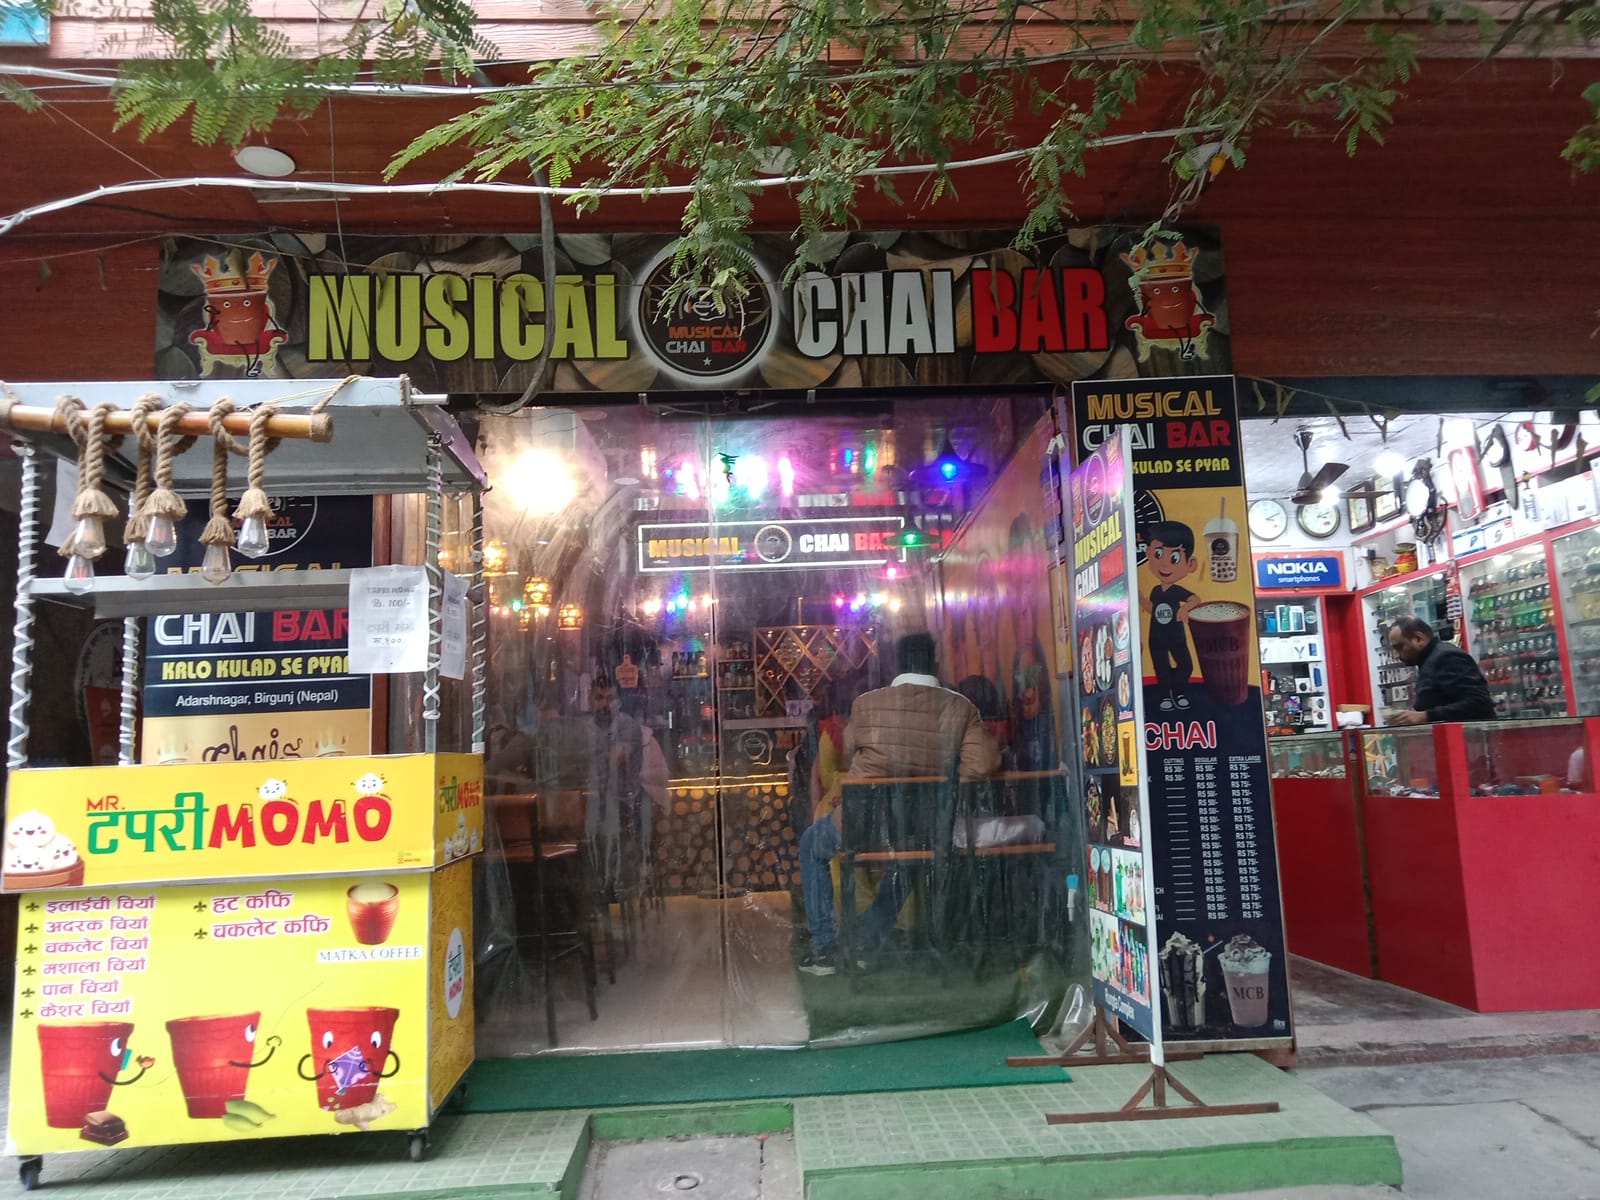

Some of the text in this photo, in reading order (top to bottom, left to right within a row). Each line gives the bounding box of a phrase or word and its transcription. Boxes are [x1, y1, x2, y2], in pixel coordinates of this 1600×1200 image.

[308, 268, 1109, 361] MUSICAL CHAI BAR
[668, 325, 740, 339] MUSICAL
[665, 340, 747, 353] CHAI BAR
[1087, 390, 1222, 420] MUSICAL
[1166, 419, 1231, 448] BAR
[1176, 459, 1192, 472] SE
[1195, 457, 1230, 472] PYAR
[649, 536, 739, 558] MUSICAL
[799, 533, 850, 552] CHAI
[1075, 511, 1122, 569] MUSICAL
[1267, 562, 1329, 575] NOKIA
[1075, 561, 1099, 599] CHAI
[1278, 576, 1320, 584] smartphones
[154, 612, 255, 646] CHAI
[216, 658, 277, 678] KULAD
[281, 657, 303, 675] SE
[176, 689, 339, 707] Adarshnagar, Birgunj (Nepal)
[1144, 721, 1217, 750] CHAI
[86, 795, 126, 811] MR.
[87, 791, 392, 854] टपरी MOMO
[212, 889, 293, 913] हट कफि
[46, 918, 104, 933] अदरक
[213, 914, 330, 938] चकलेट कफि
[319, 946, 421, 961] MATKA COFFEE
[43, 961, 101, 975] मशाला
[42, 983, 74, 996] पान
[1232, 986, 1265, 1001] MCB
[40, 1002, 85, 1017] केशर
